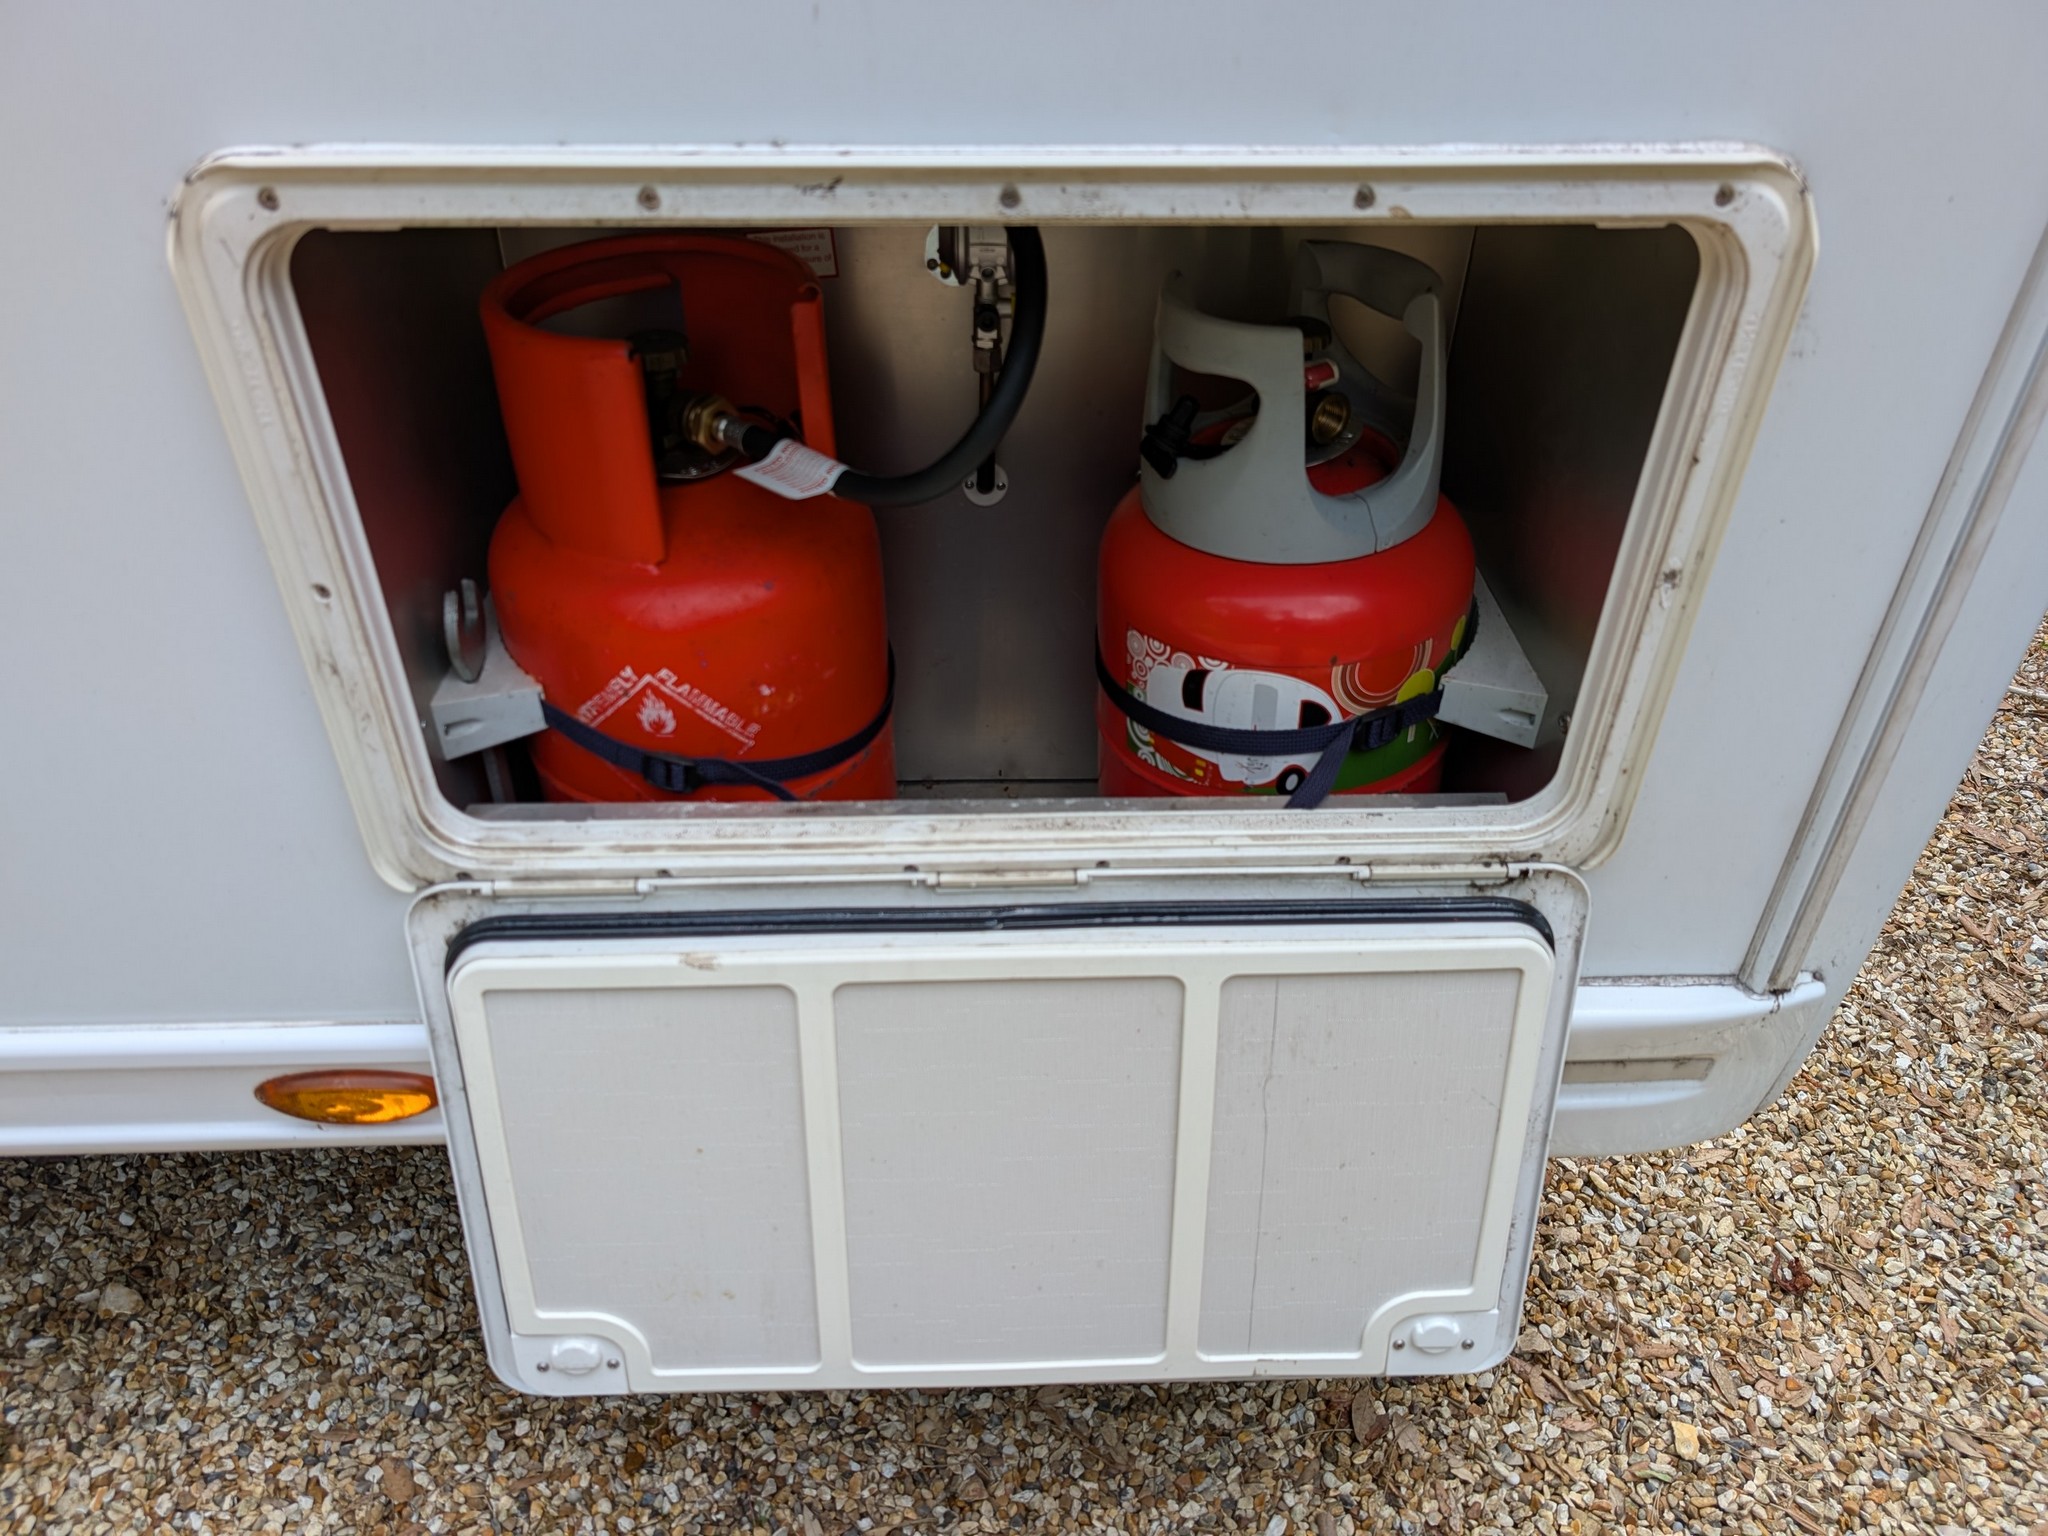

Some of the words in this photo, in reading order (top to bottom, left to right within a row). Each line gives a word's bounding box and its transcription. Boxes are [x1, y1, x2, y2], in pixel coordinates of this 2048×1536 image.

[773, 233, 816, 242] installation
[818, 232, 826, 240] is
[801, 243, 812, 251] for
[824, 254, 831, 262] of
[654, 667, 762, 740] FLAMMABLE
